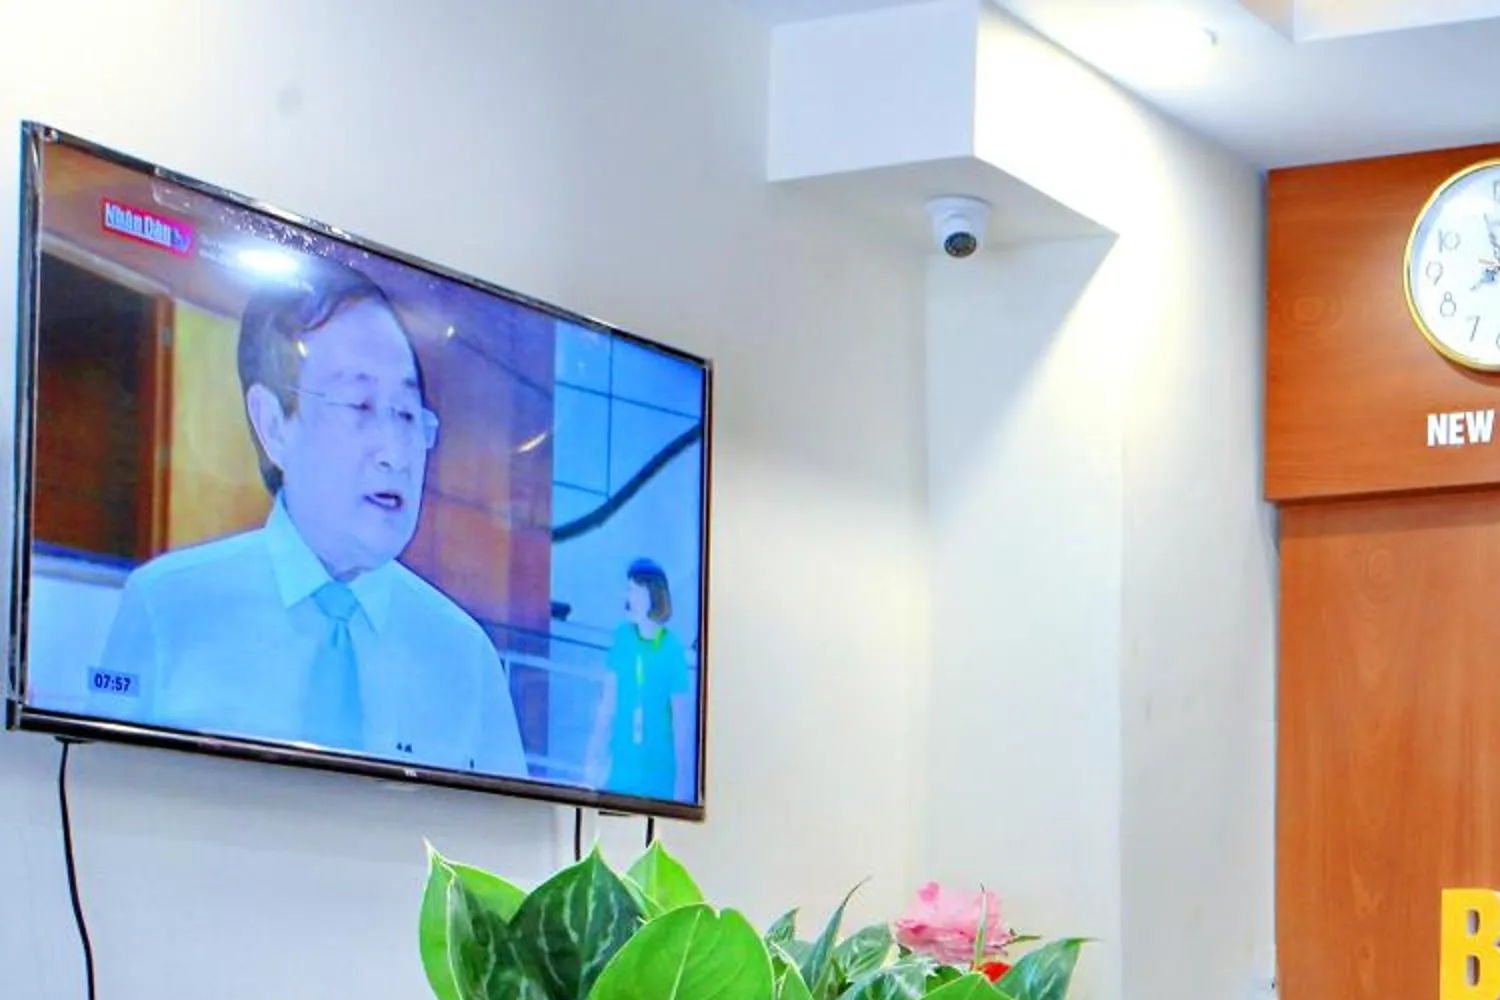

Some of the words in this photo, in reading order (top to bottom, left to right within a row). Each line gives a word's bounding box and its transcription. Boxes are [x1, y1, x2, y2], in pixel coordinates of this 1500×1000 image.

[1438, 228, 1461, 253] 10
[1426, 261, 1443, 286] 9
[1440, 292, 1457, 317] 8
[1467, 316, 1480, 342] 7
[1427, 409, 1494, 447] NEW
[94, 673, 131, 692] 07:57
